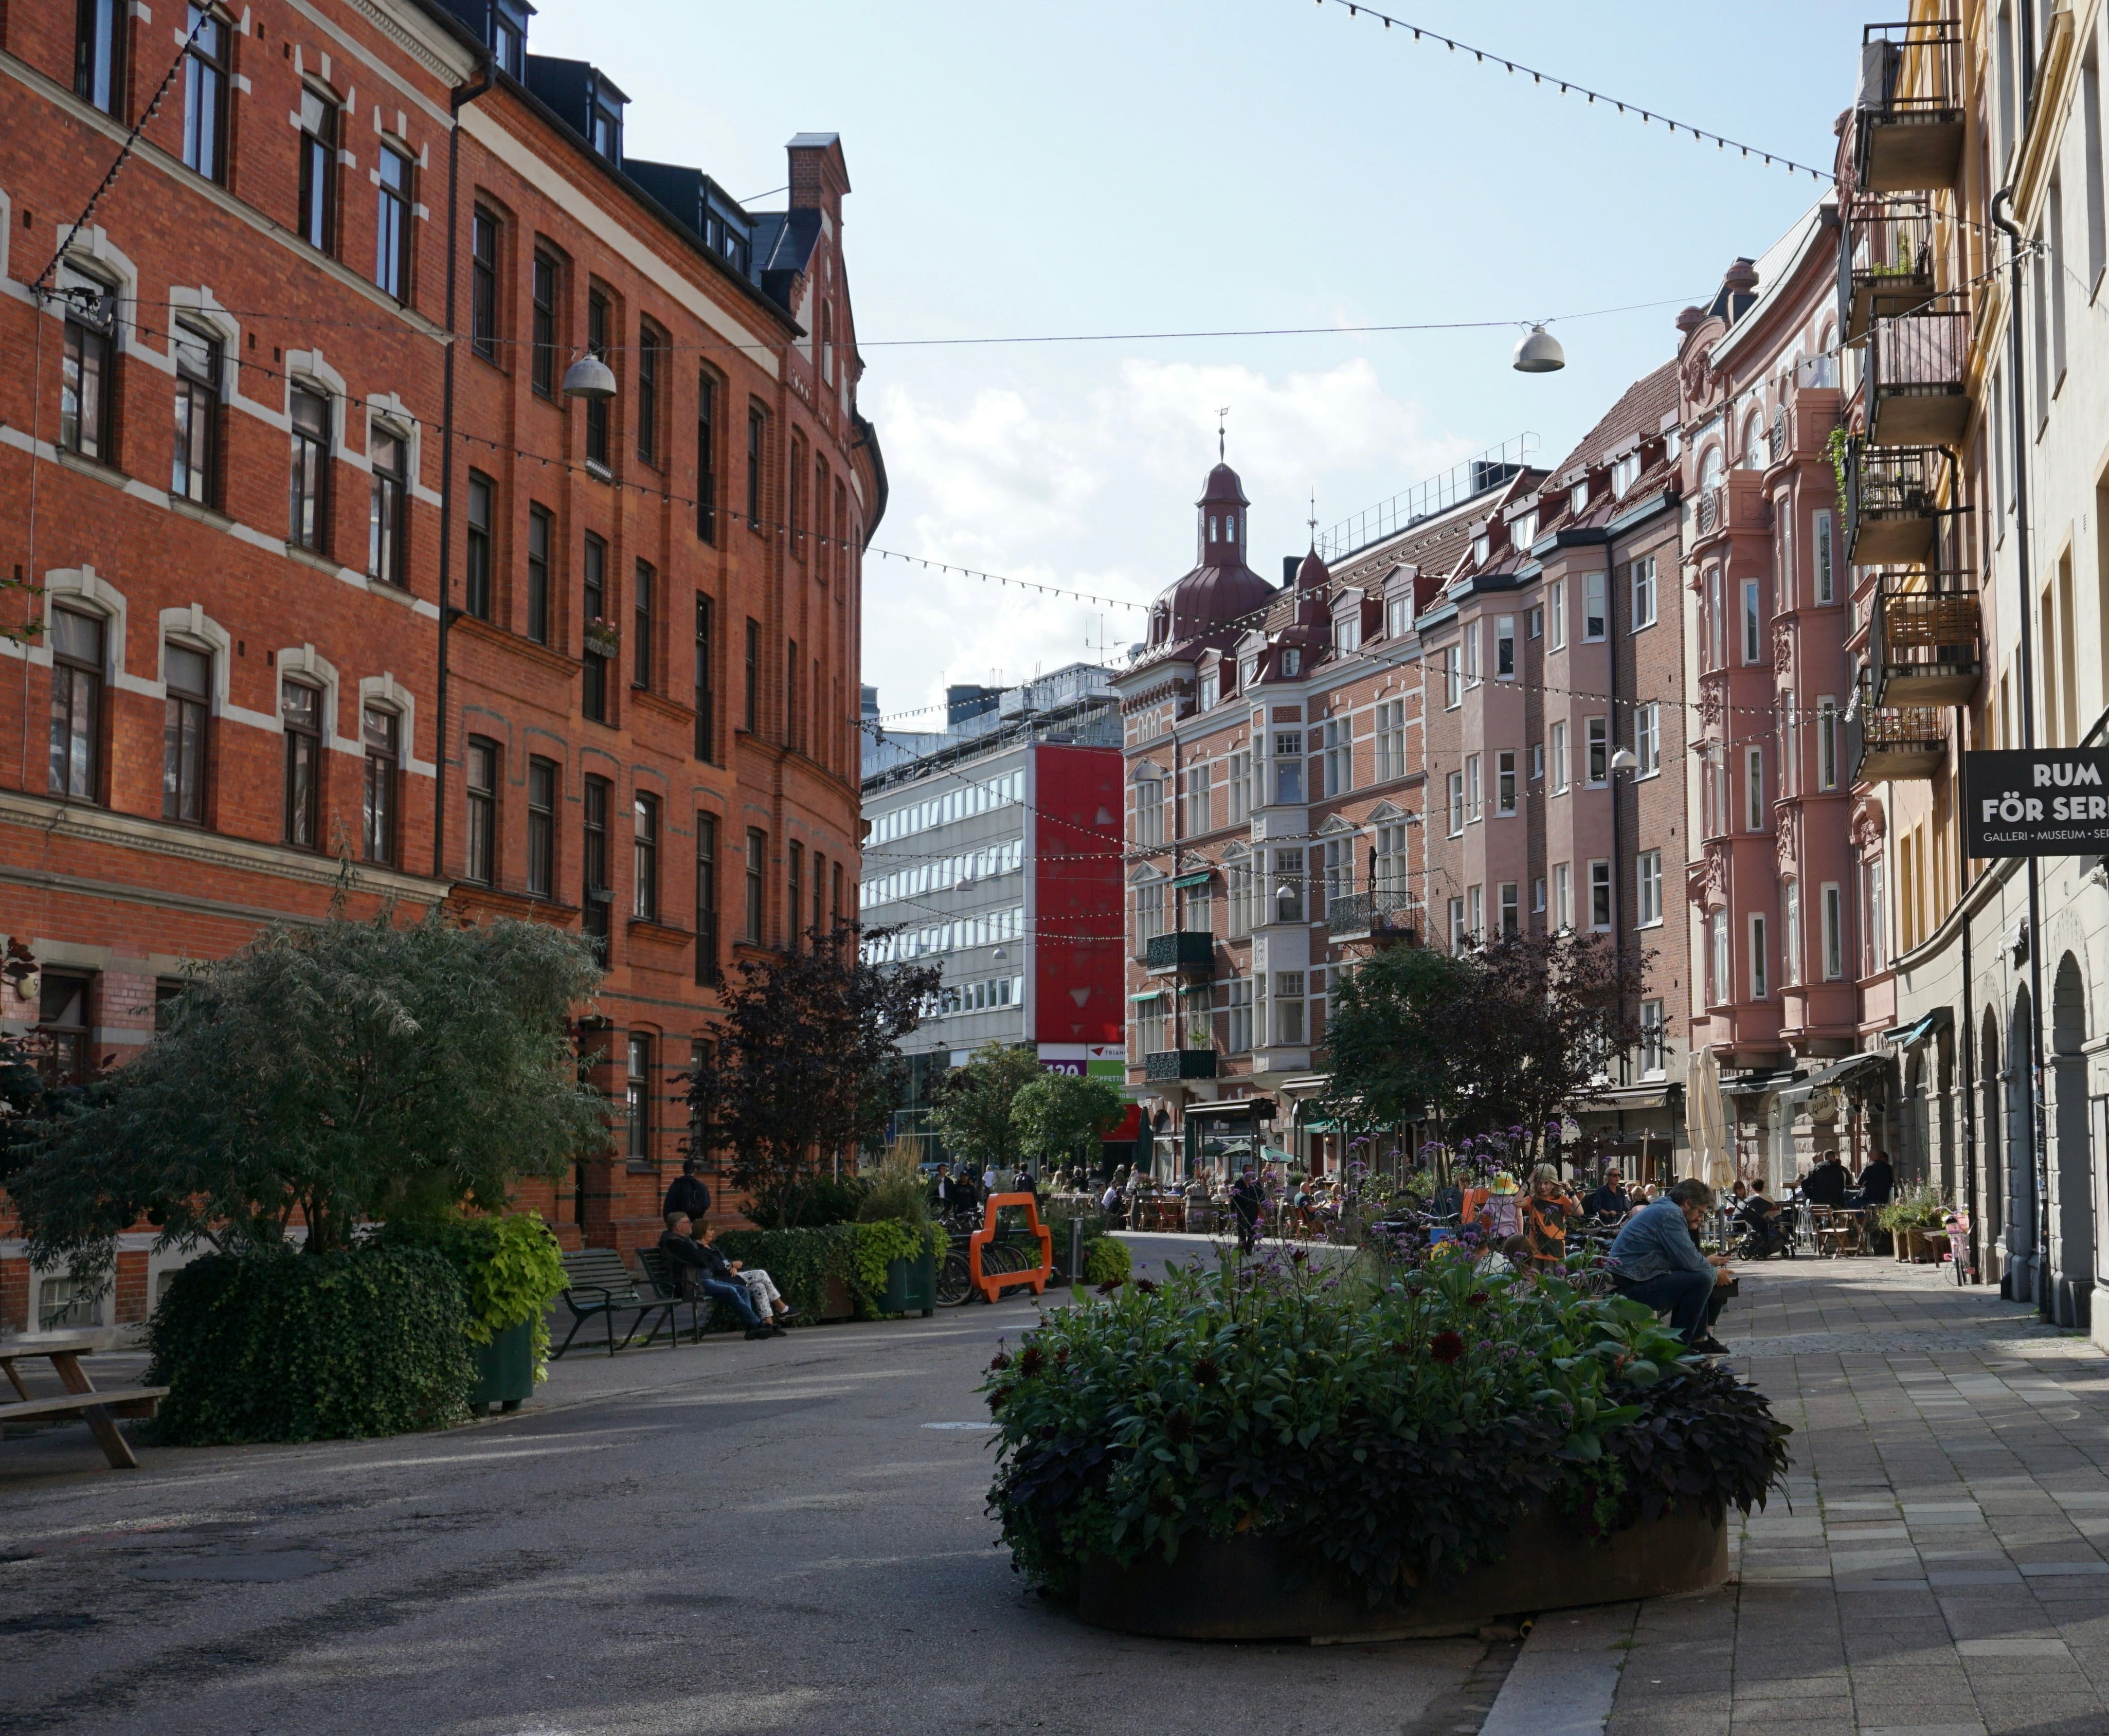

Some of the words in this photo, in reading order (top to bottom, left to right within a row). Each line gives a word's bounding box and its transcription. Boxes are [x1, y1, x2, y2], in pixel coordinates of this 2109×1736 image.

[2033, 762, 2103, 787] RUM
[1982, 791, 2045, 822] FÖR
[2052, 795, 2109, 821] SER
[1983, 831, 2027, 842] GALLERI
[2036, 829, 2086, 840] MUSEUM
[33, 979, 39, 990] 9
